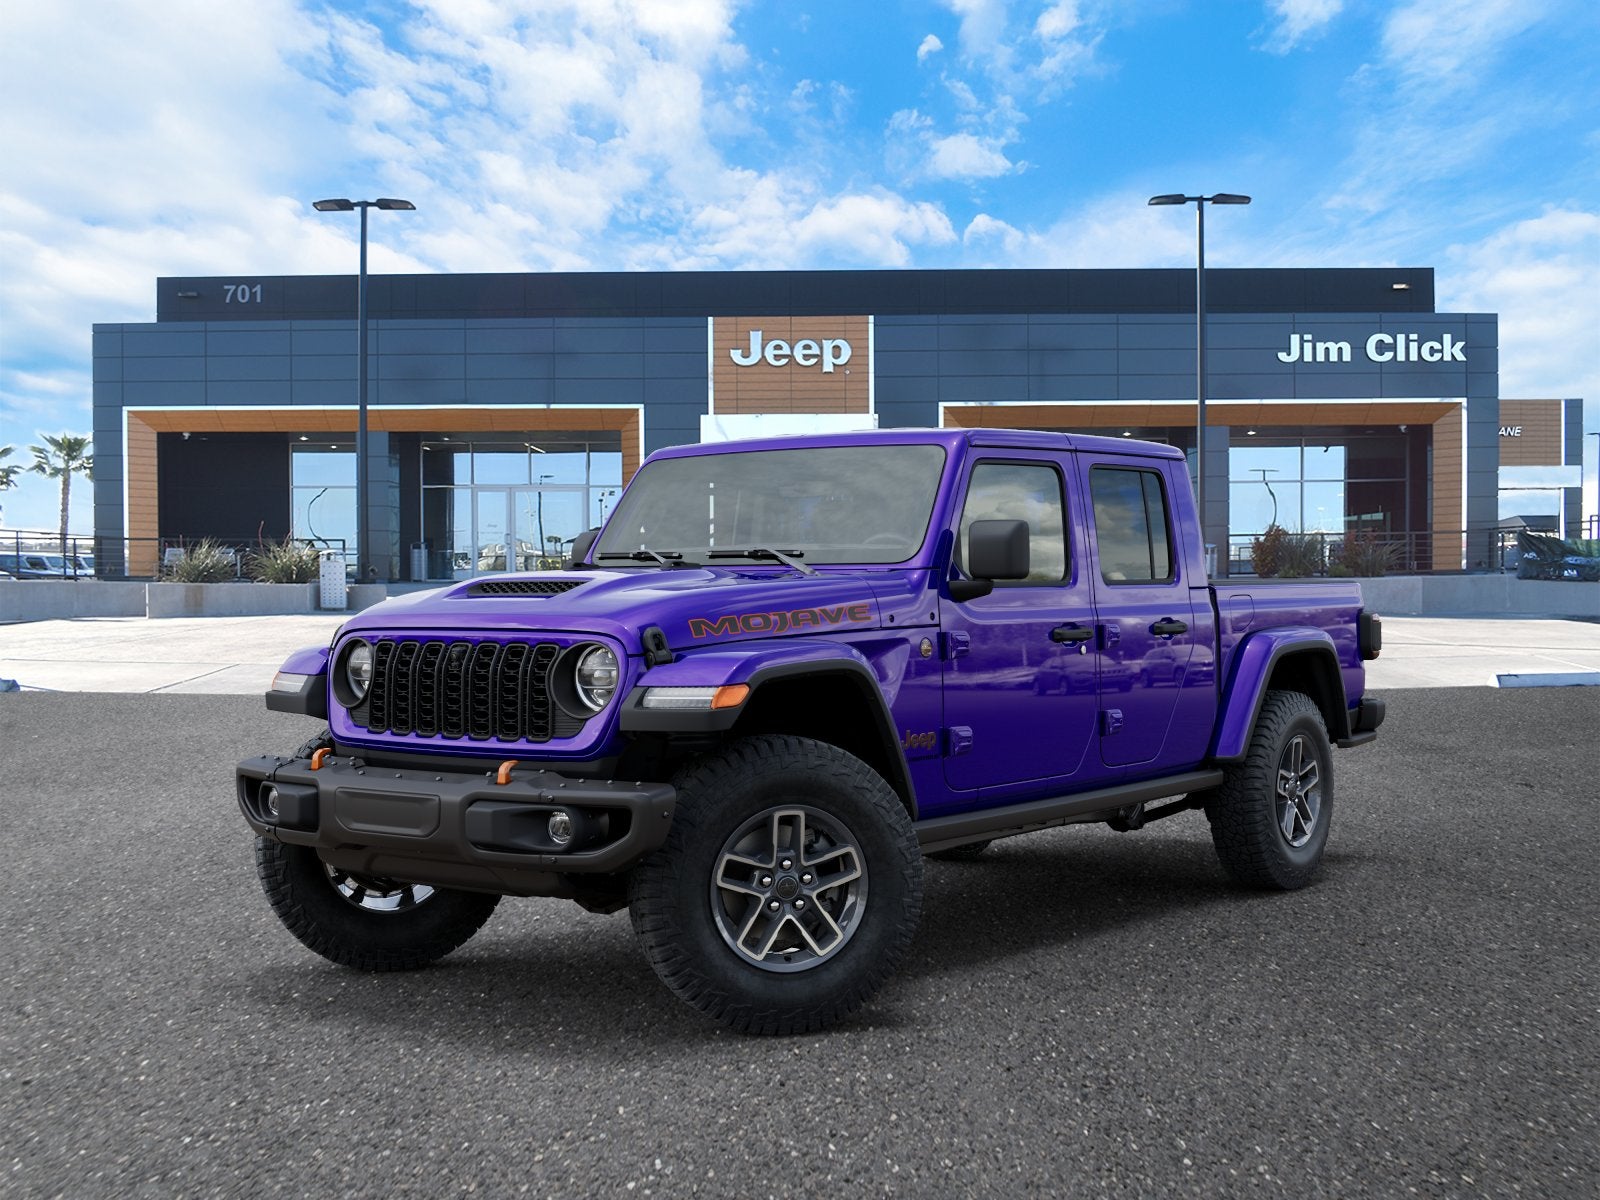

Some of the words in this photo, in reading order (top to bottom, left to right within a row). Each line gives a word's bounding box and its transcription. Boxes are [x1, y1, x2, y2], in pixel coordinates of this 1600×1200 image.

[223, 284, 262, 303] 701
[729, 329, 852, 374] Jeep
[1277, 334, 1351, 362] Jim
[1365, 333, 1467, 362] Click
[688, 603, 872, 639] MOJAVE
[901, 729, 936, 750] Jeep
